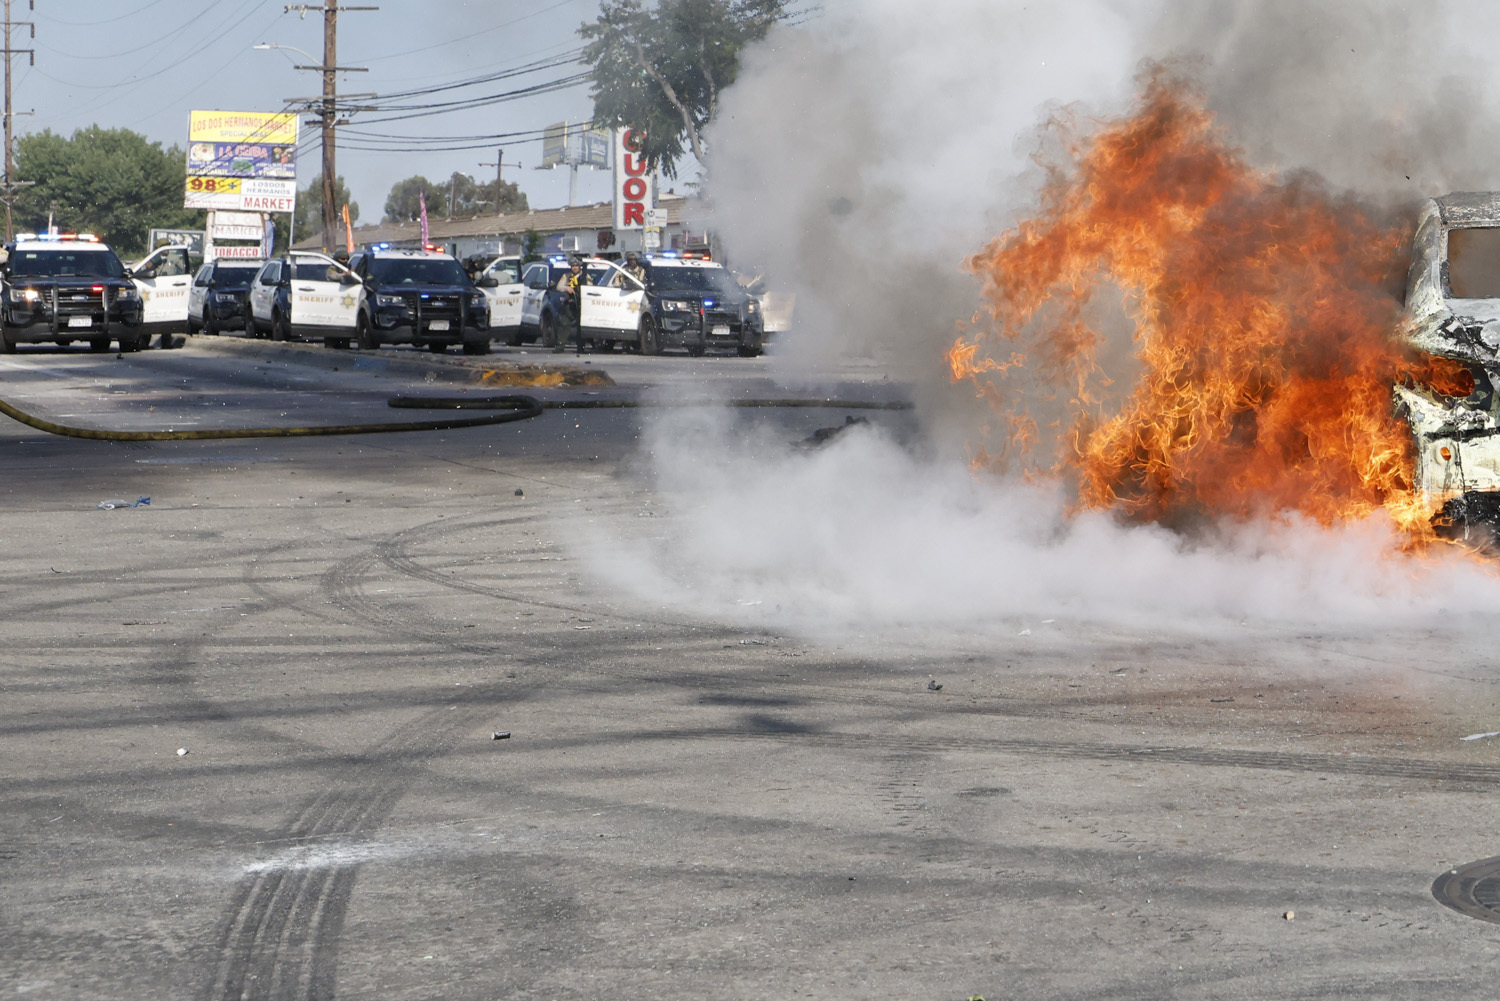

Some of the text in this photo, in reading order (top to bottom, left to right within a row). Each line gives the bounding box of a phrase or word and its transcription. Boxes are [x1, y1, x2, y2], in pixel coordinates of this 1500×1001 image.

[193, 120, 206, 132] LOS
[208, 118, 222, 129] DOS
[224, 116, 263, 128] HERMANOS
[244, 197, 292, 210] MARKET
[215, 226, 260, 236] MARKET
[214, 247, 259, 257] TOBACCO
[299, 295, 334, 303] SHERIFF
[591, 300, 622, 308] SHERIFF
